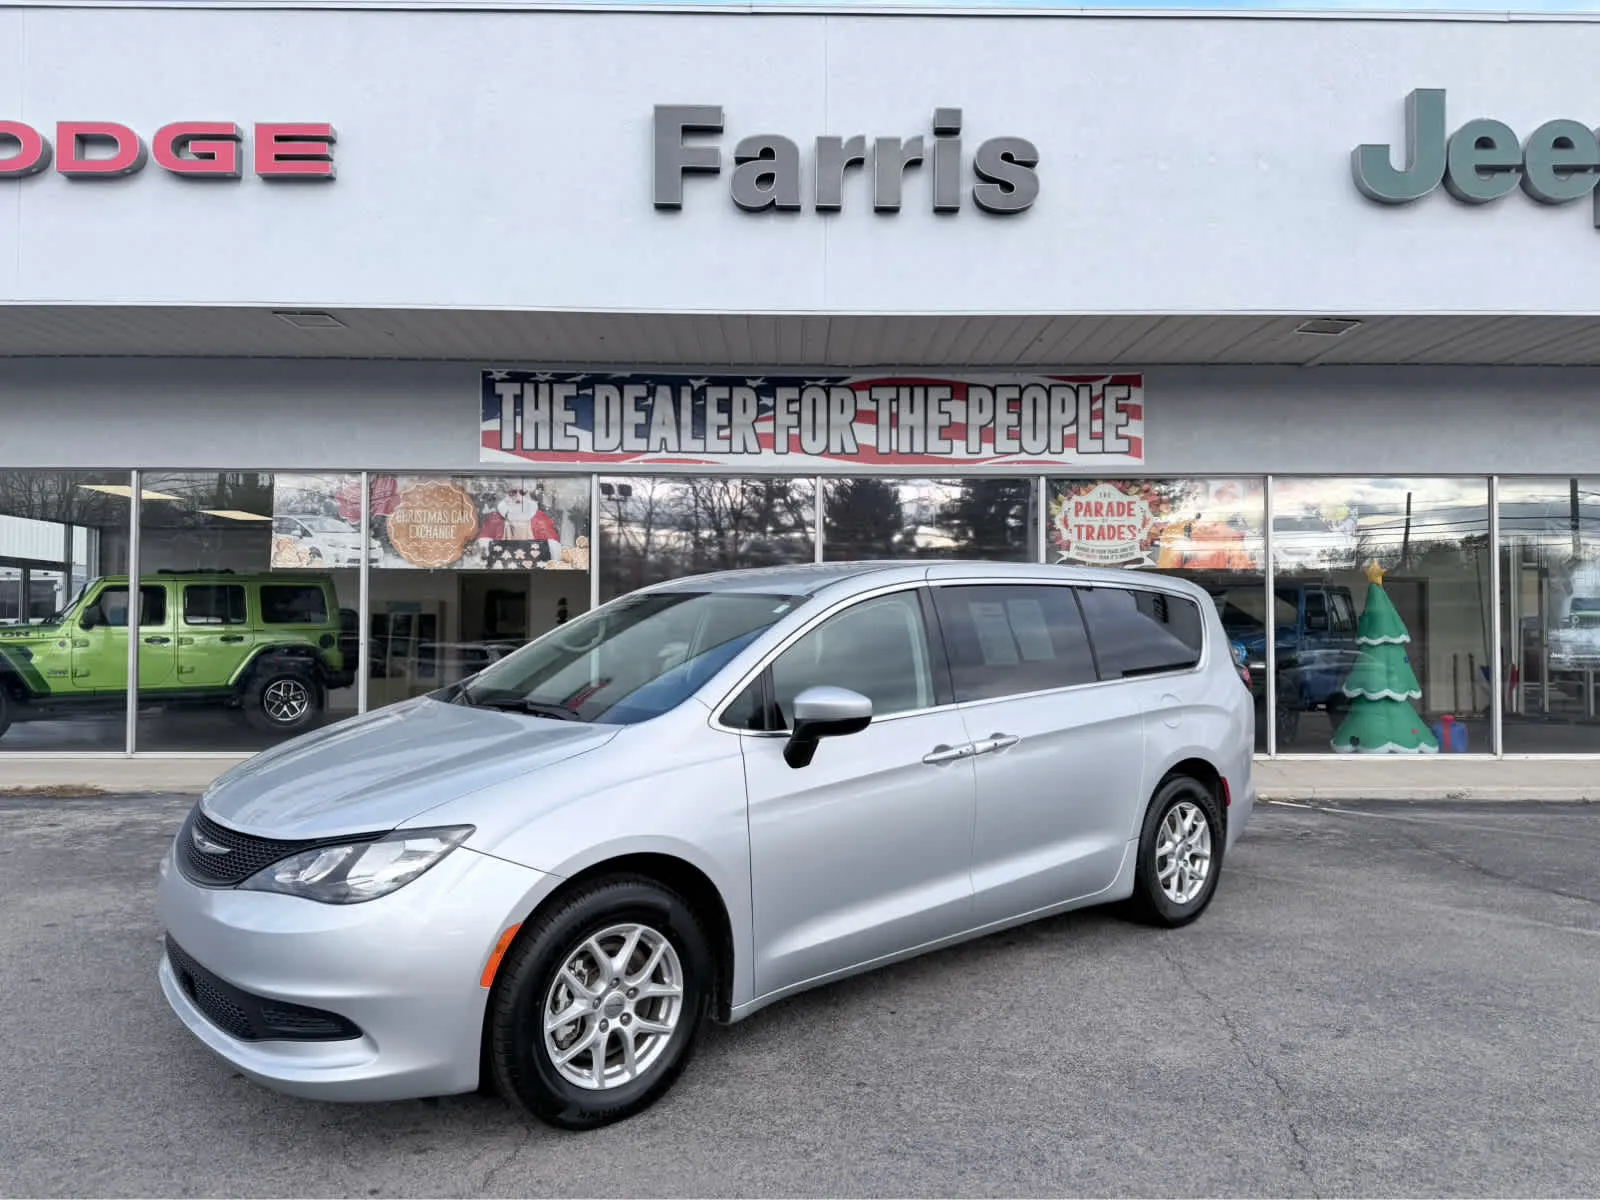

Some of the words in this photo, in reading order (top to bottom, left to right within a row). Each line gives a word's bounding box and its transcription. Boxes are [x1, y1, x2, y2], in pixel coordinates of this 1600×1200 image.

[653, 104, 1040, 214] Farris
[1351, 88, 1600, 229] Jee
[494, 381, 580, 452] THE
[592, 383, 761, 454] DEALER
[773, 384, 859, 455] FOR
[869, 384, 953, 455] THE
[965, 384, 1132, 455] PEOPLE
[1073, 524, 1137, 541] TRADES
[1074, 500, 1137, 518] PARADE
